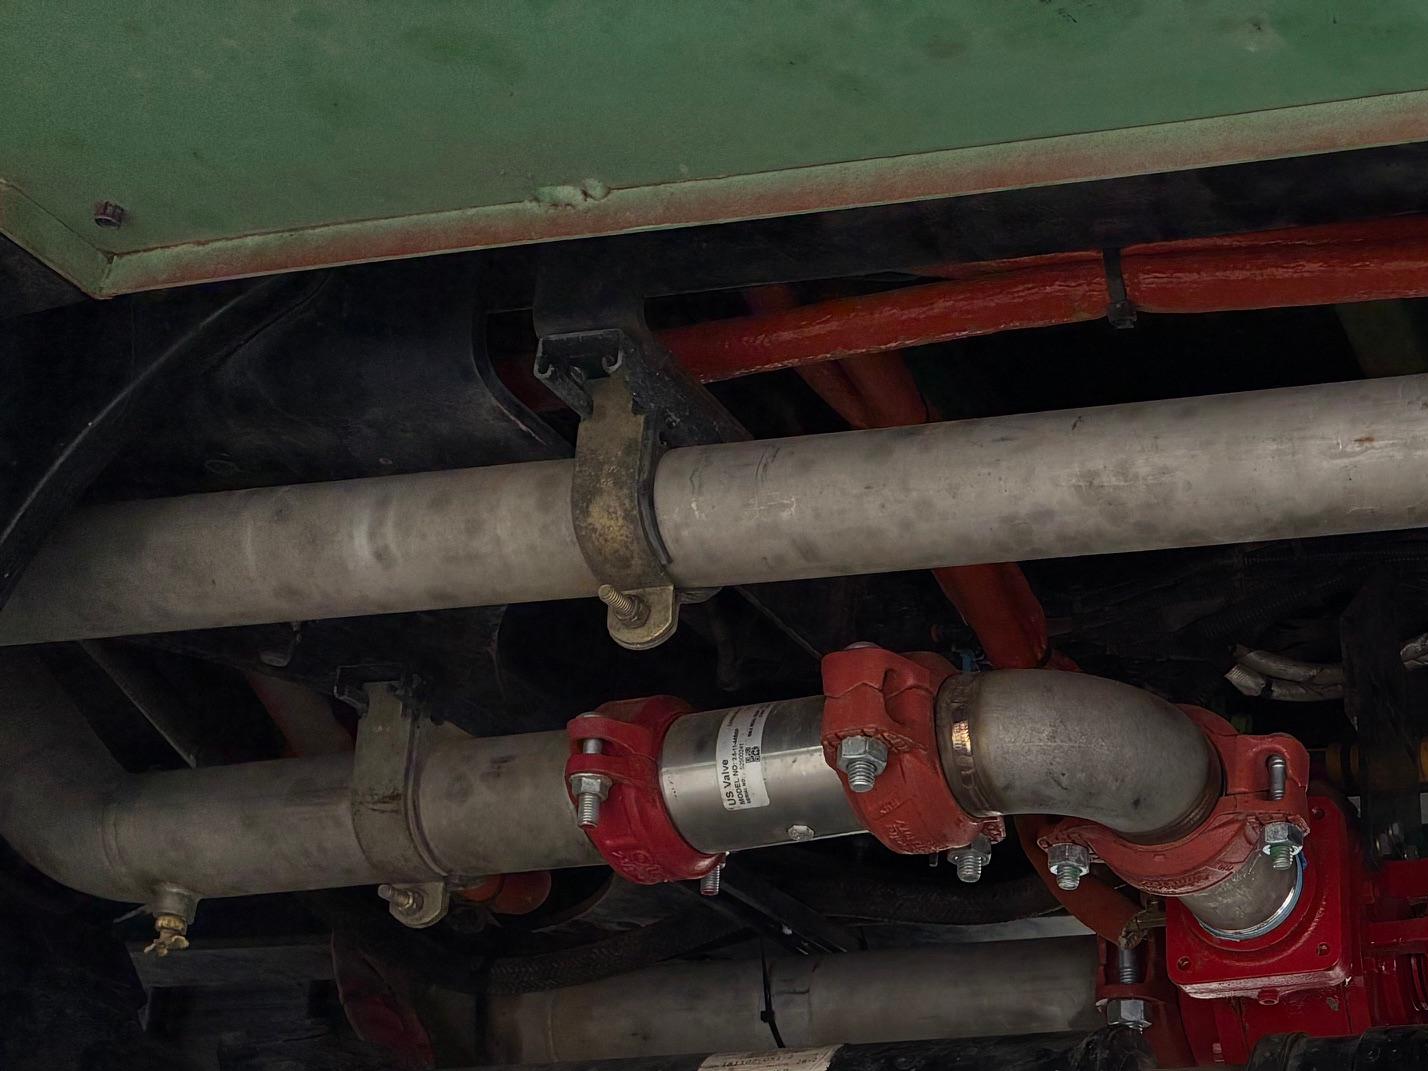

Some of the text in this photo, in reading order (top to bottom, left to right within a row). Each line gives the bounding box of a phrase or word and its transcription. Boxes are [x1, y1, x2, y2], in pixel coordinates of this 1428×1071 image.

[721, 759, 737, 806] US Valve
[734, 778, 746, 805] MODEL
